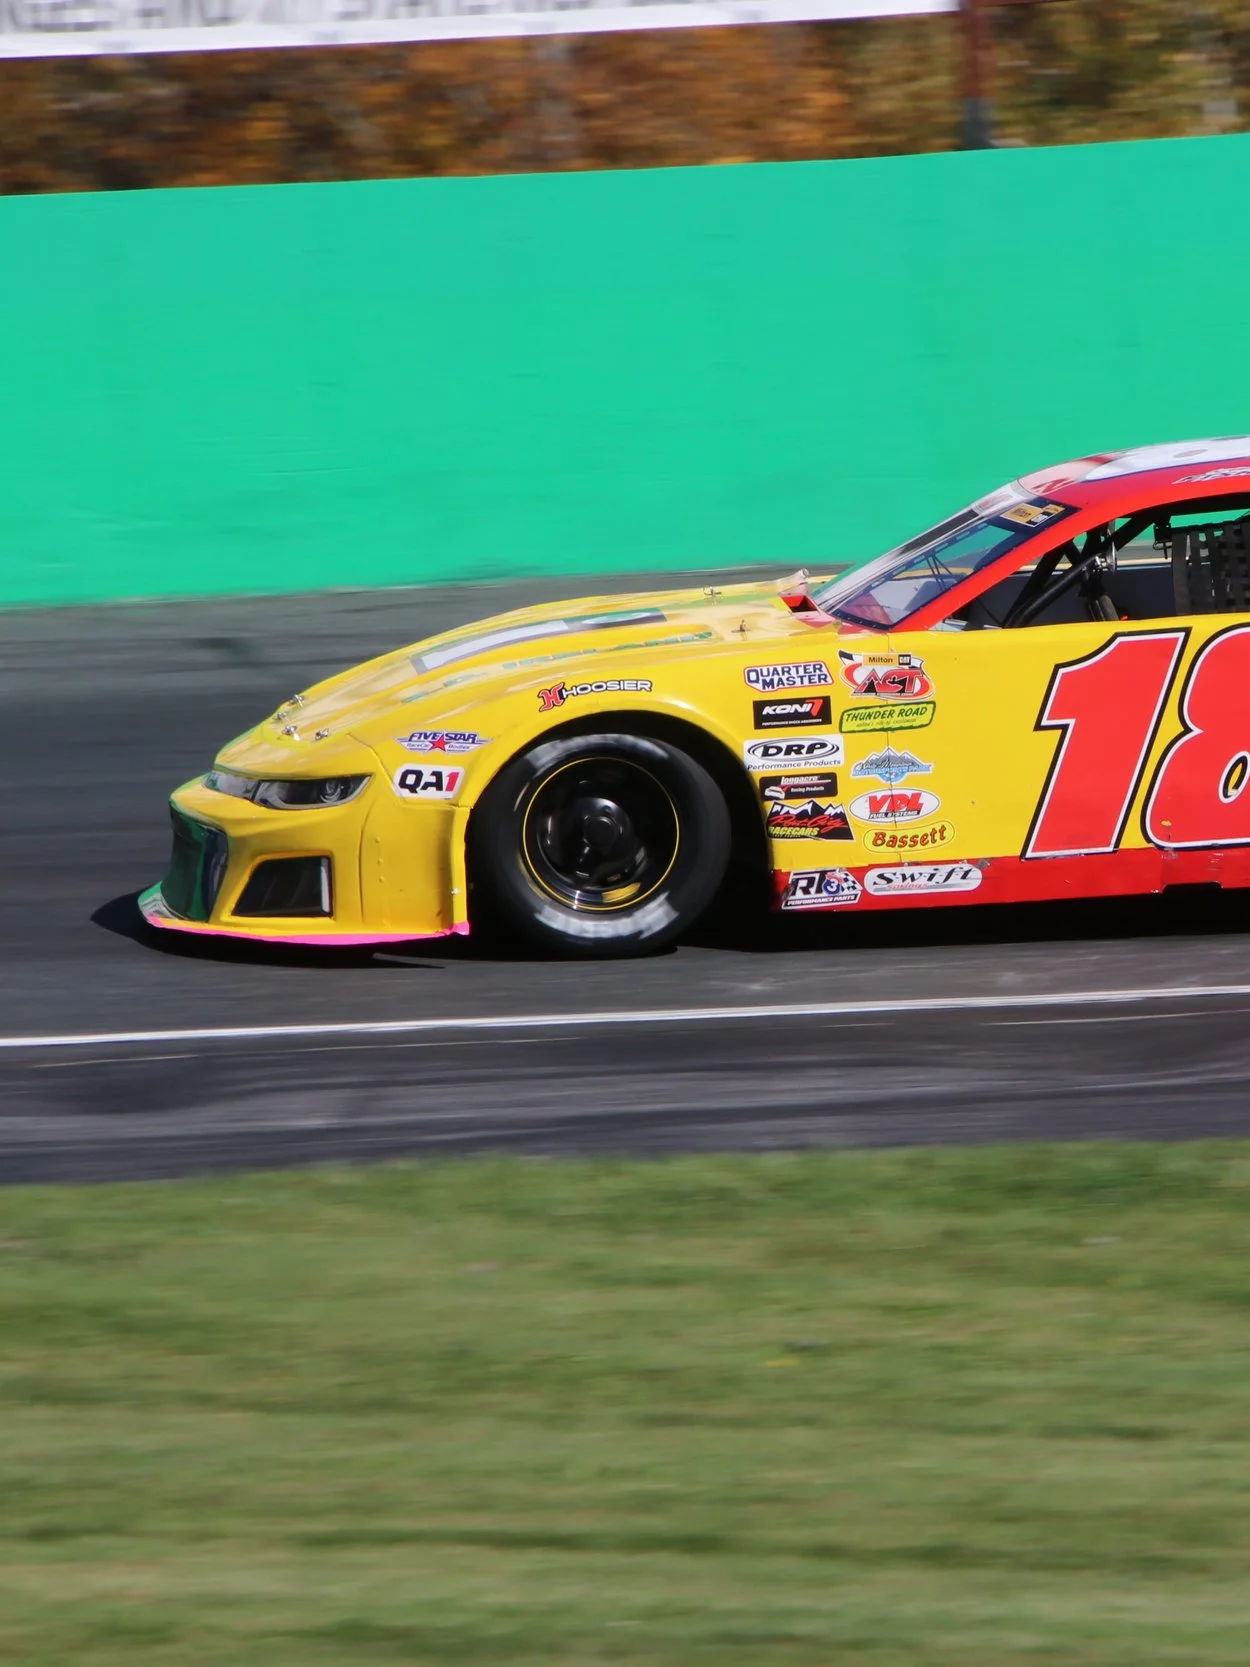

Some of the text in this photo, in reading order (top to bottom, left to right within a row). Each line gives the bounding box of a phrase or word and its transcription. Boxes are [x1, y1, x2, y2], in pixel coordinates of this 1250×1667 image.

[868, 656, 893, 664] Milton
[746, 663, 823, 684] QUARTER
[762, 673, 828, 690] MASTER
[854, 668, 924, 693] ACT
[562, 680, 652, 698] HOOSIER
[762, 703, 813, 715] KONI
[846, 706, 928, 722] THUNDER ROAD
[408, 731, 477, 744] FIVE STAR
[761, 742, 828, 757] DRP
[747, 759, 841, 771] Performance Products
[398, 769, 460, 794] QA1
[872, 825, 946, 848] Bassett
[873, 866, 973, 886] Swift
[787, 897, 833, 906] PERFORMANCE
